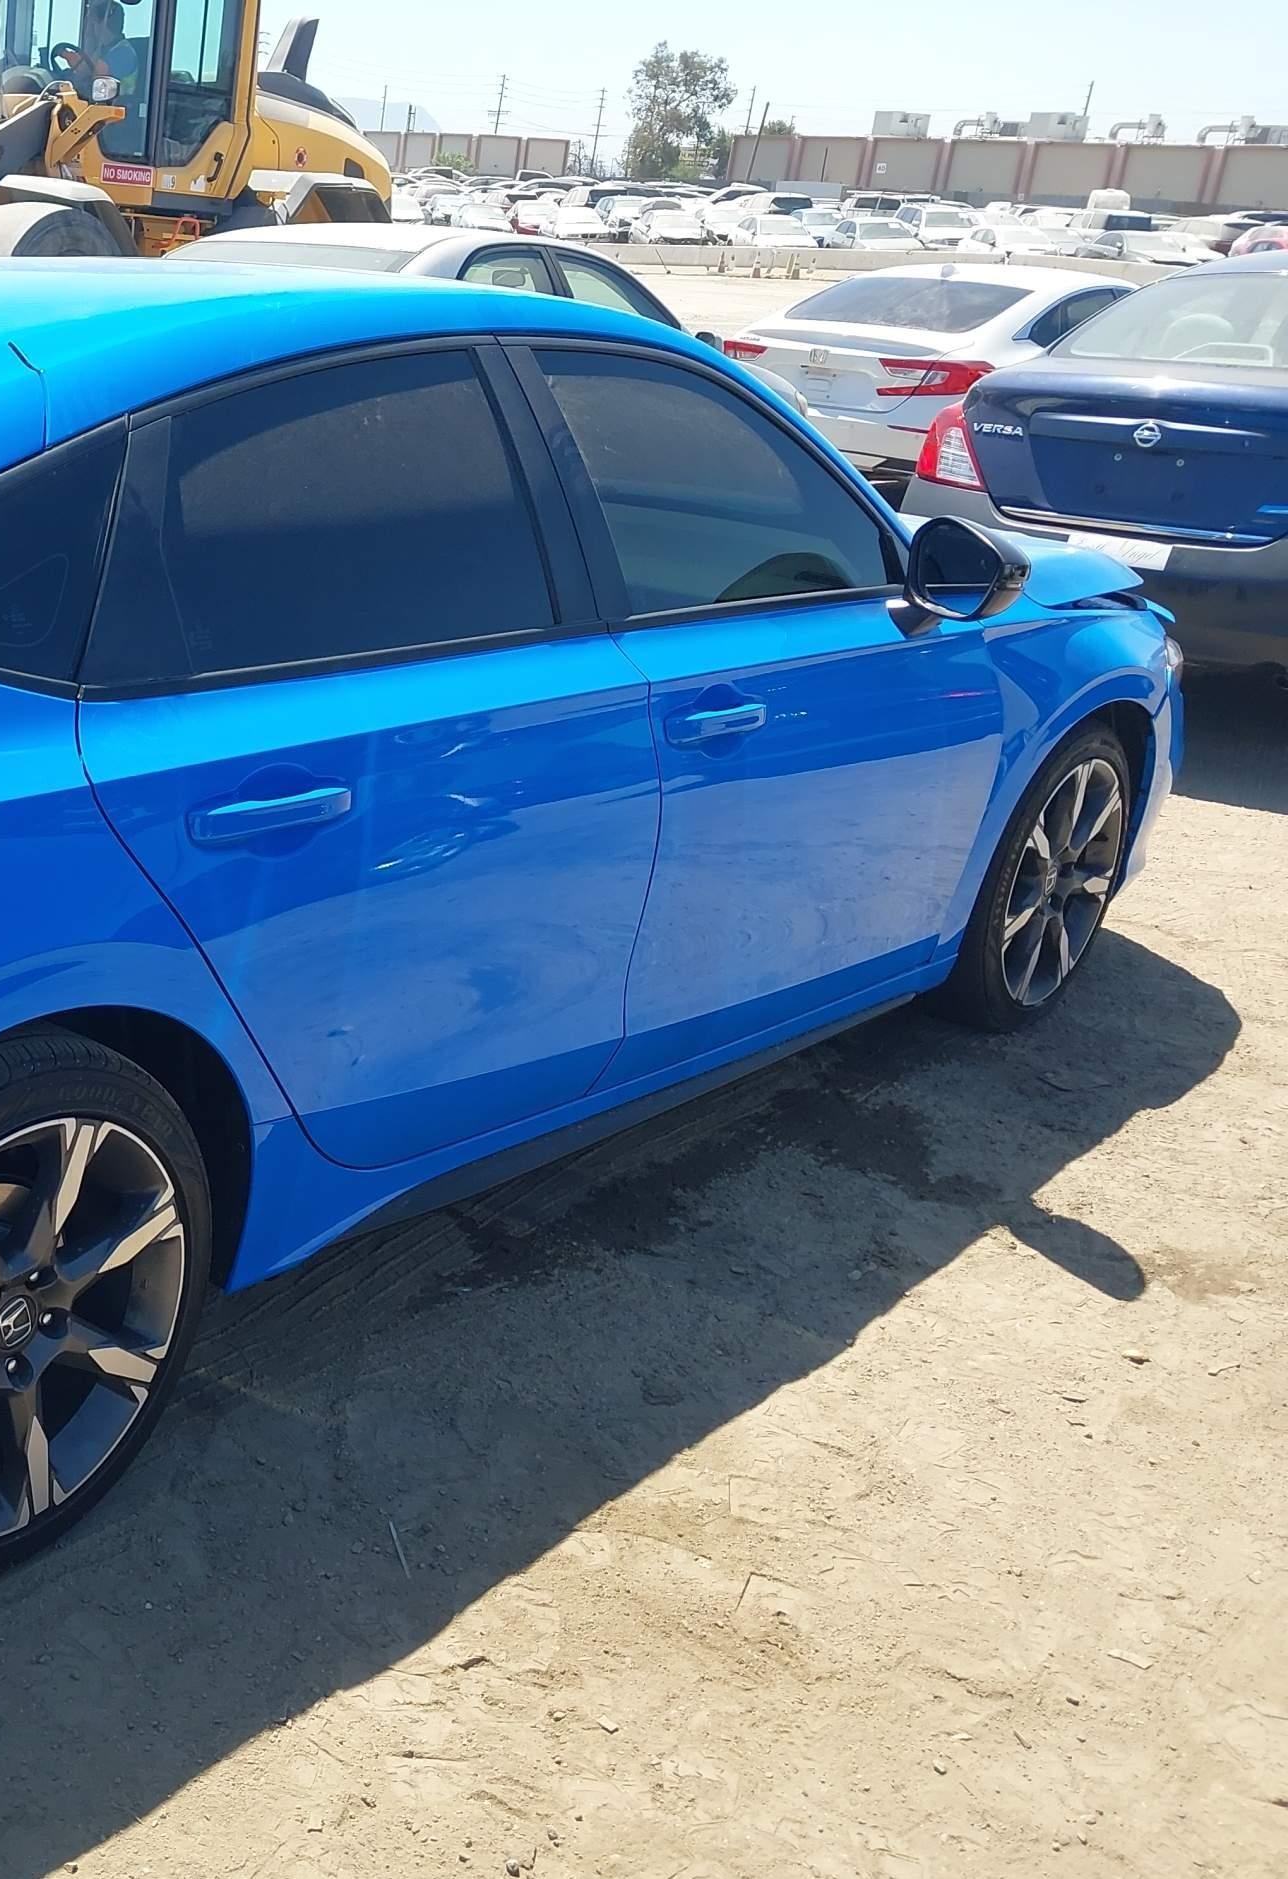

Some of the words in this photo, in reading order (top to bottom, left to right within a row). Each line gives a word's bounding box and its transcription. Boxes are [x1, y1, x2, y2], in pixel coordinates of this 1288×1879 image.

[103, 167, 115, 179] NO
[116, 168, 151, 182] SMOKING
[972, 422, 1025, 437] VERSA
